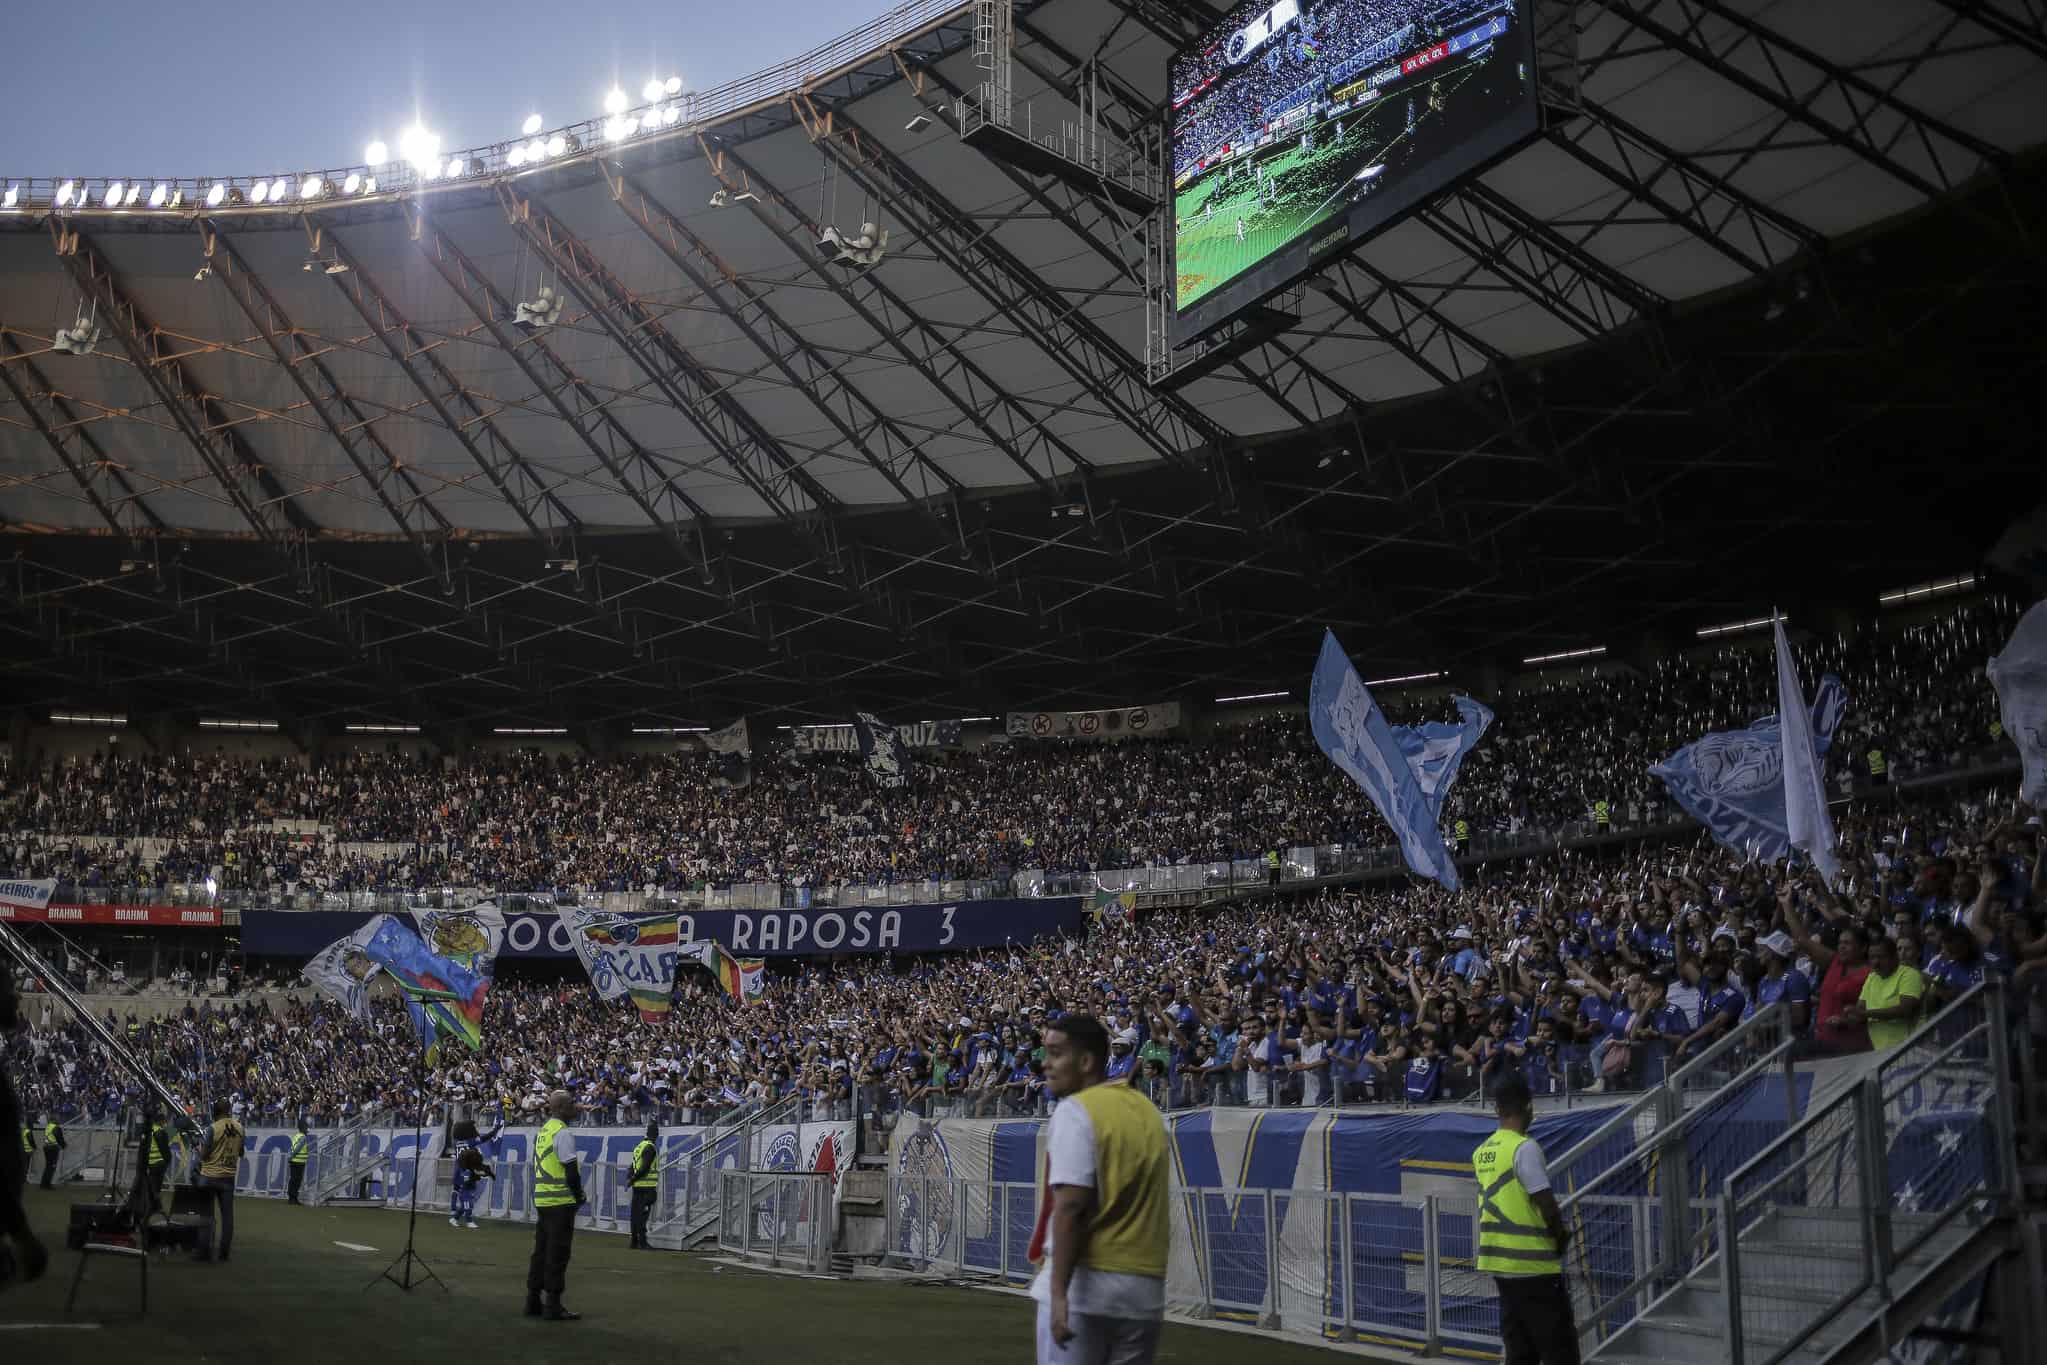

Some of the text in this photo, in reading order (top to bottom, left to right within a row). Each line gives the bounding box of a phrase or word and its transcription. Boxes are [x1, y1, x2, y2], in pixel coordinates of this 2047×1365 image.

[813, 722, 940, 751] FANA RUZ
[48, 907, 83, 921] BRAHMA
[115, 908, 149, 921] BRAHMA
[181, 911, 214, 922] BRAHMA
[732, 909, 901, 951] RAPOSA
[940, 906, 955, 945] 3
